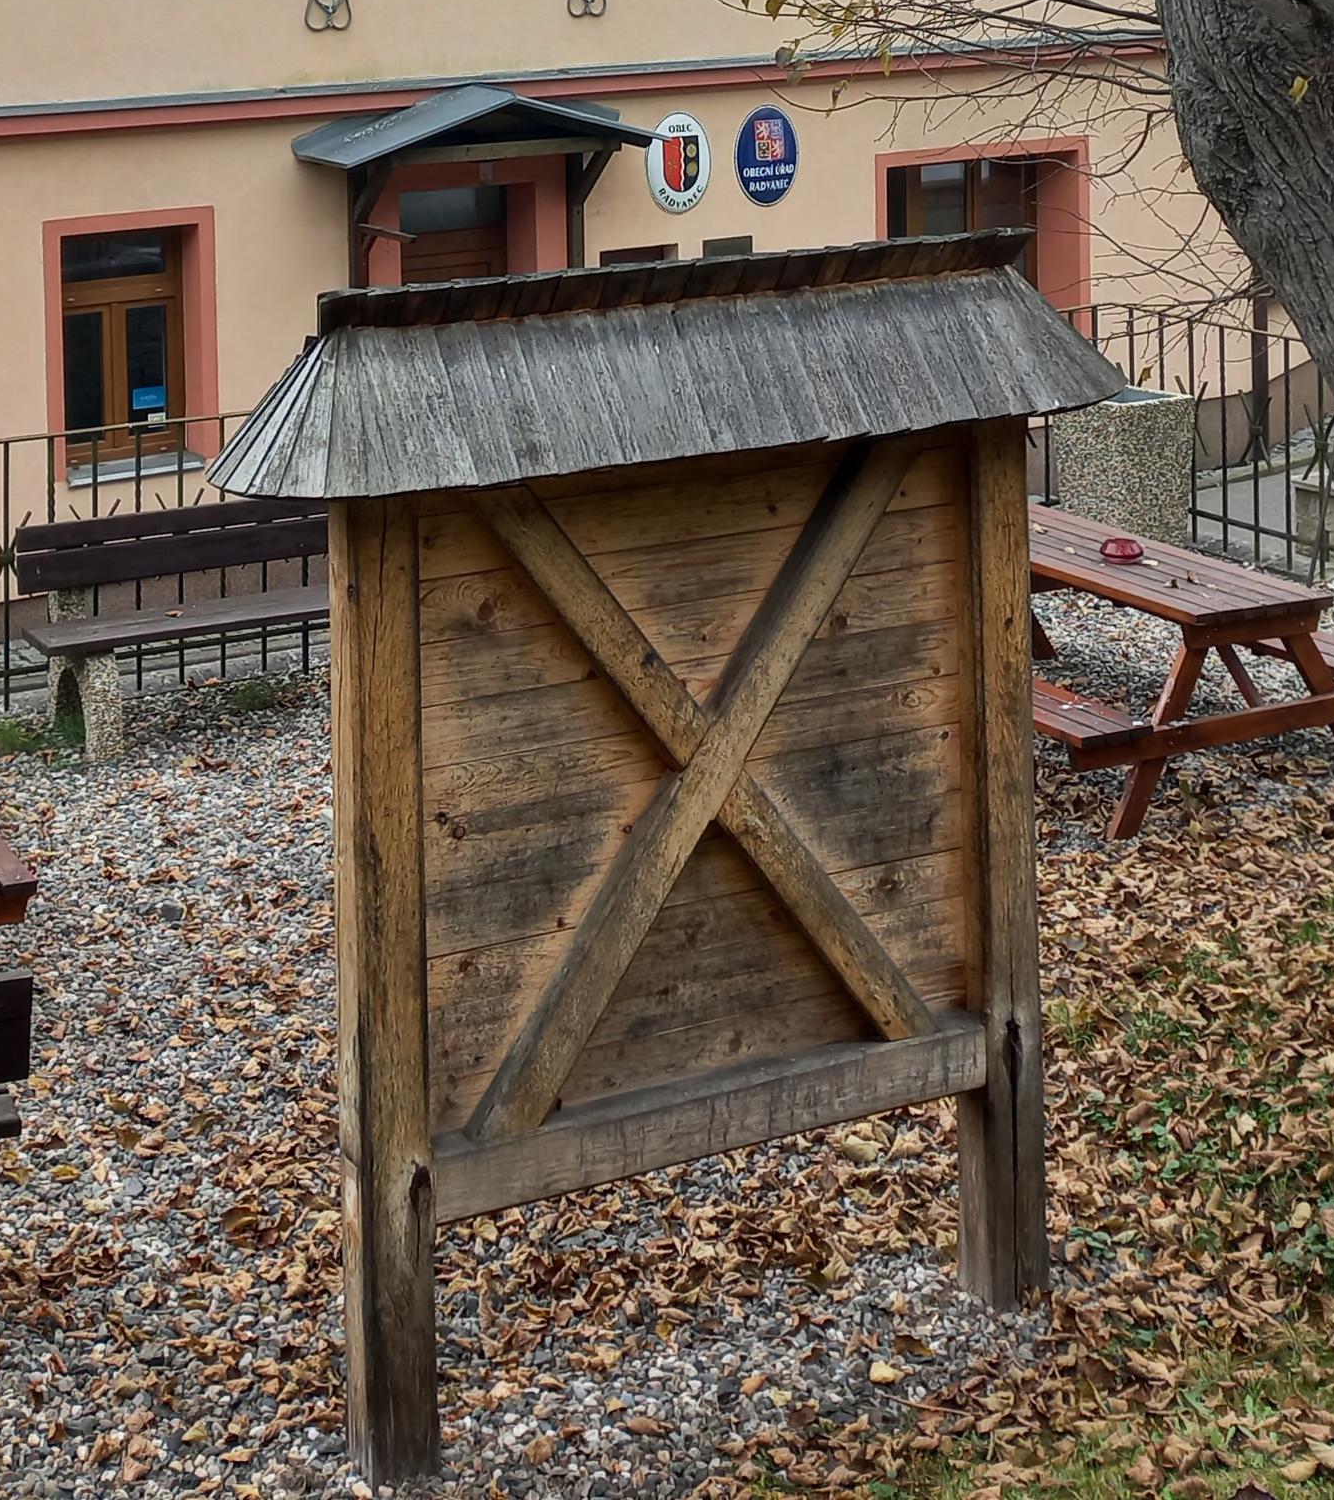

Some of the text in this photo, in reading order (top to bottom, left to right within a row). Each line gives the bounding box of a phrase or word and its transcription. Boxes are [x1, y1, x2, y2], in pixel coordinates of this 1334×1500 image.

[668, 123, 693, 134] OBEC
[743, 162, 795, 178] OBECNÍ ÚŘAD
[749, 179, 789, 192] RADVANEC
[658, 184, 704, 209] RADVANEC
